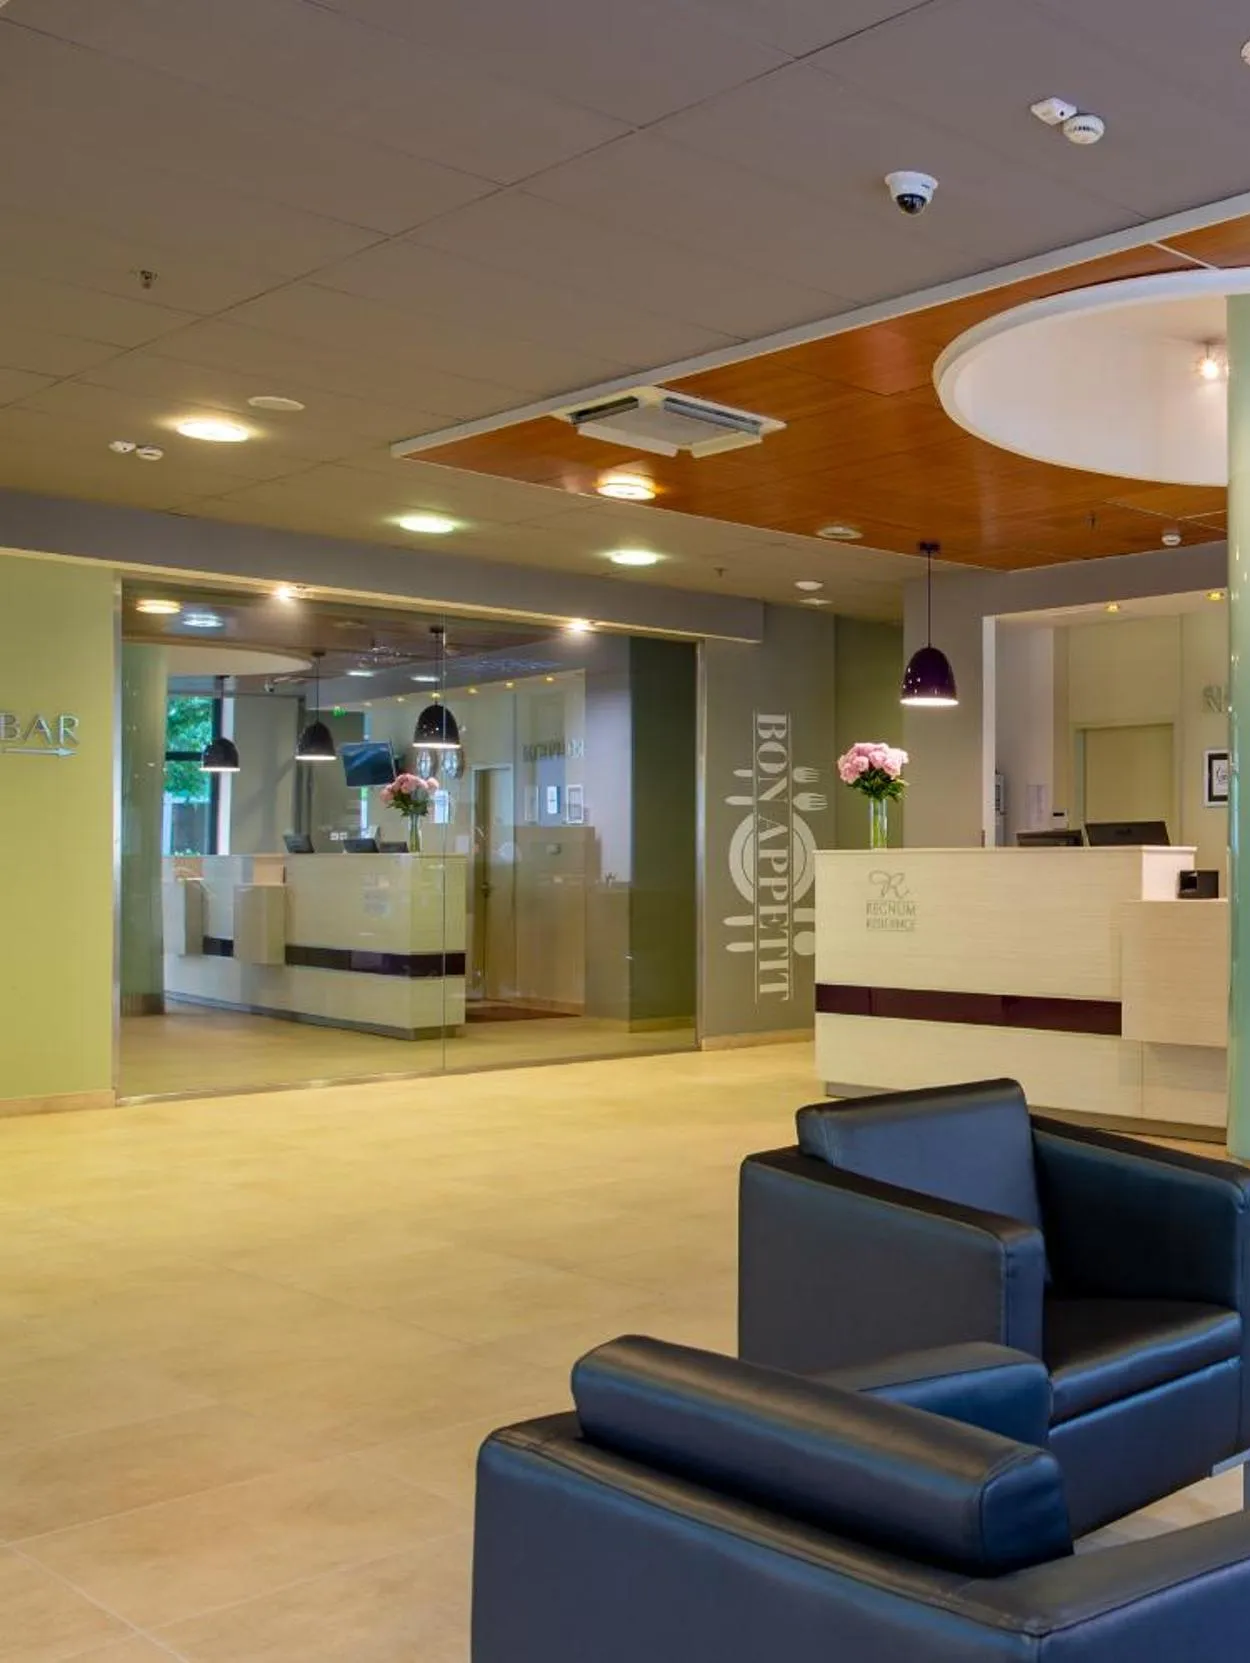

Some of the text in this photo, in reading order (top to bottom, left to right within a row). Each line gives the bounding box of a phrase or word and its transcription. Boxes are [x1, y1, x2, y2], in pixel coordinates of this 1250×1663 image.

[0, 712, 79, 744] BAR
[757, 713, 789, 1001] BON APPETIT
